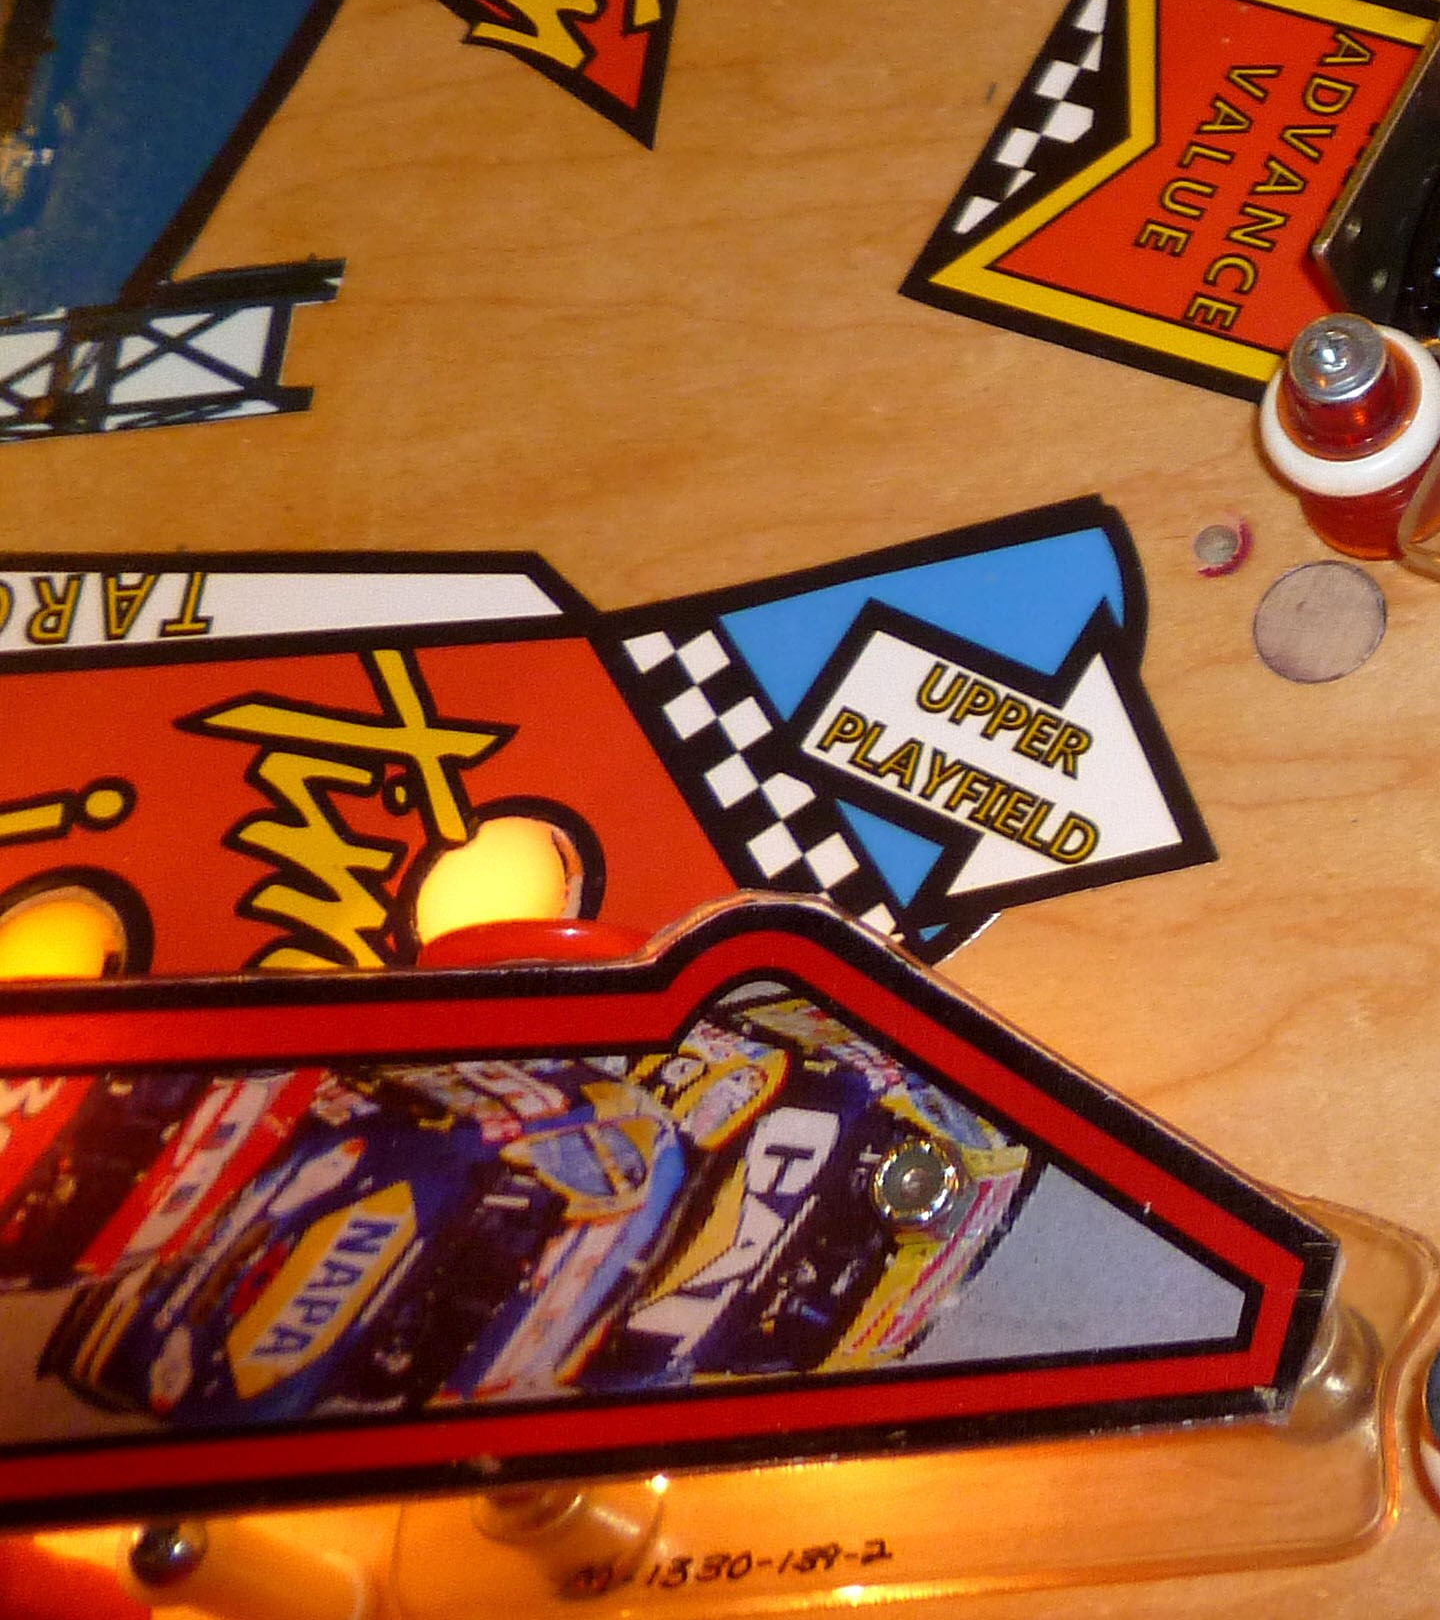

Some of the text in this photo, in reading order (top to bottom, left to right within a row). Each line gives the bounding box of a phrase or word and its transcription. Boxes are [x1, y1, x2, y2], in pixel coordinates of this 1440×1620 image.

[1133, 62, 1283, 259] VALUE
[1184, 28, 1377, 332] ADVANCE
[0, 572, 214, 645] TAR
[816, 705, 1102, 867] PLAYFIELD
[915, 661, 1093, 780] UPPER
[250, 1218, 401, 1358] NAPA
